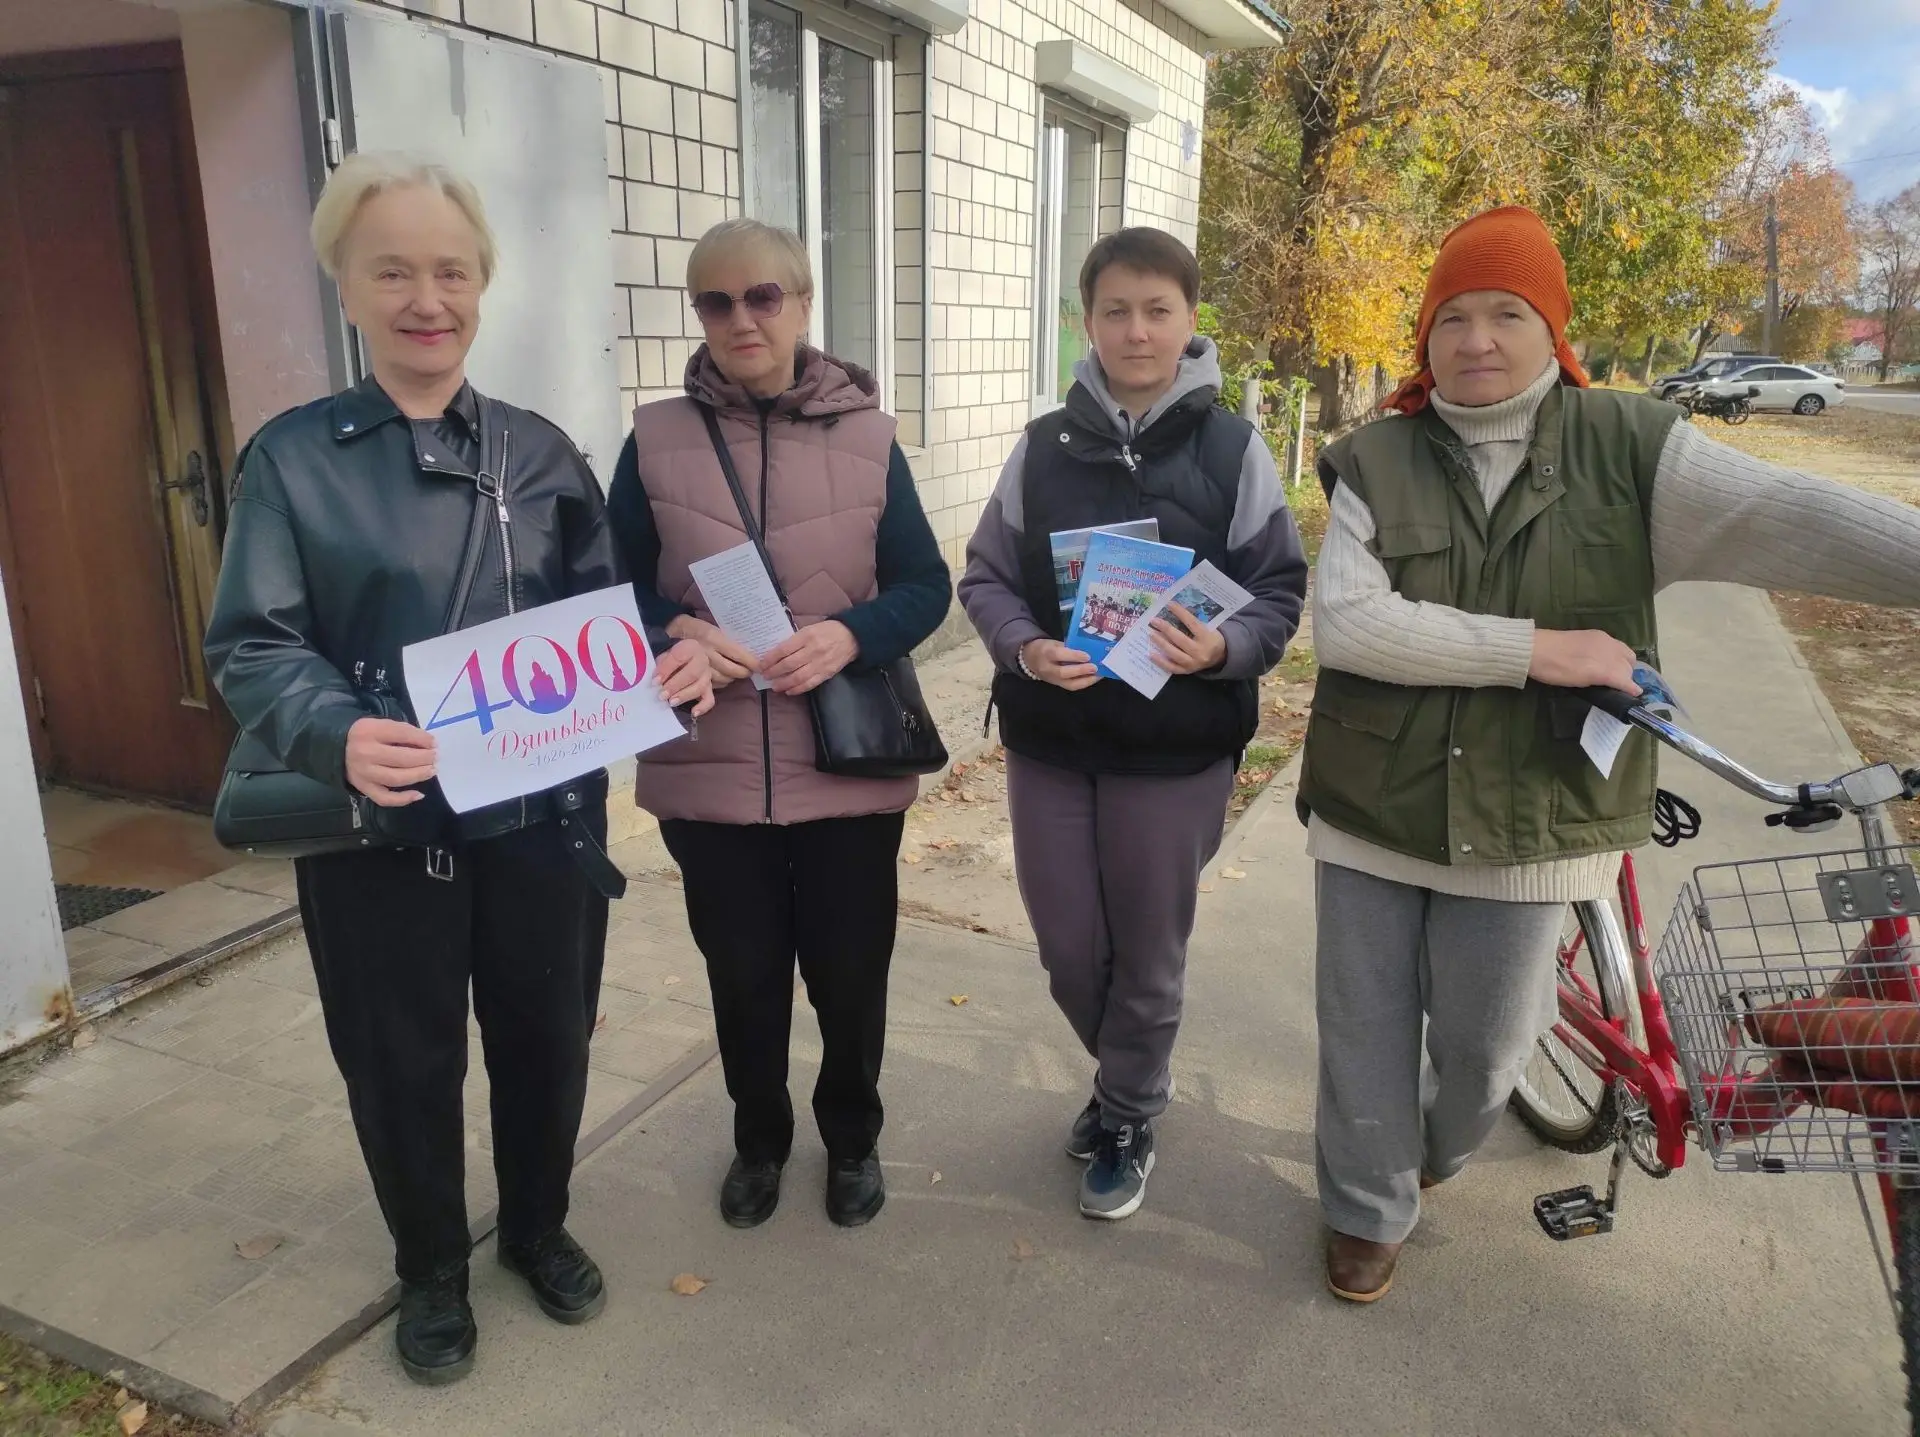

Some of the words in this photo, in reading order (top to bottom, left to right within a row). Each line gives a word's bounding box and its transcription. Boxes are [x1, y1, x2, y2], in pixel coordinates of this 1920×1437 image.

[1140, 583, 1167, 594] ИСТОРИ
[1108, 620, 1128, 633] ПОЛ
[425, 615, 647, 735] 400
[487, 697, 625, 760] Дятьково
